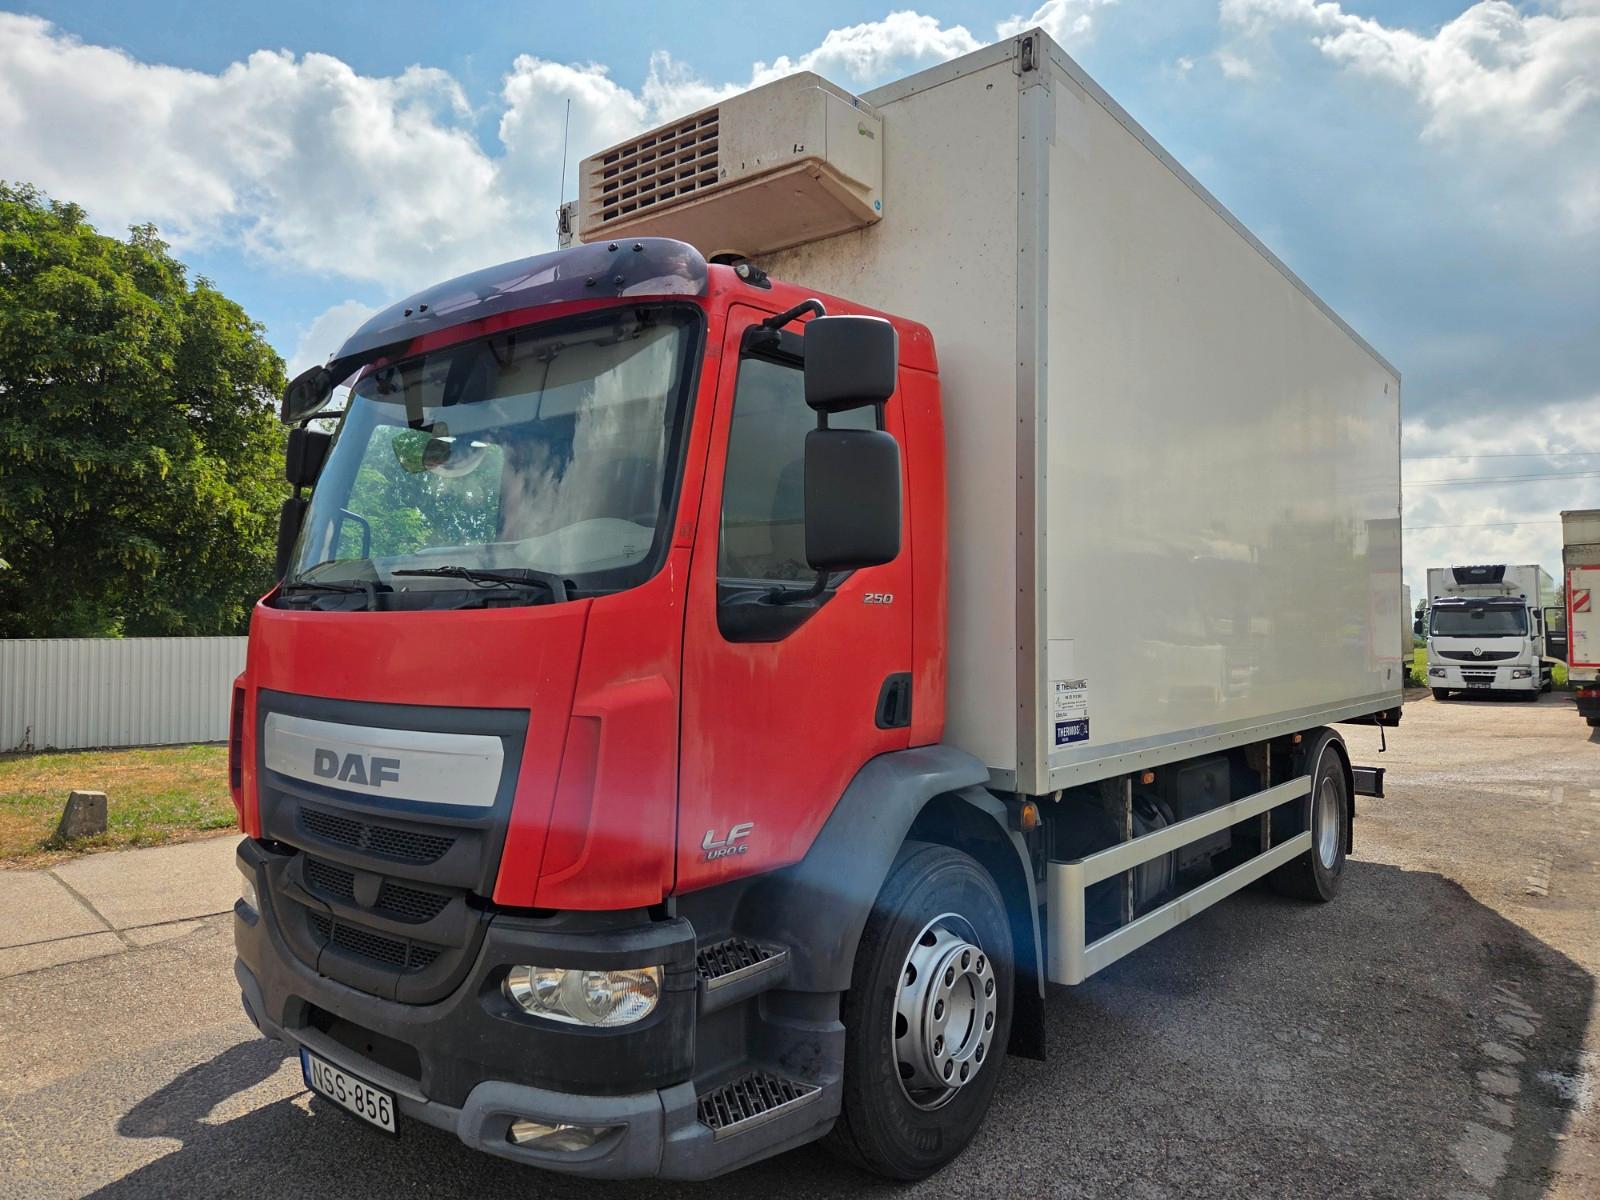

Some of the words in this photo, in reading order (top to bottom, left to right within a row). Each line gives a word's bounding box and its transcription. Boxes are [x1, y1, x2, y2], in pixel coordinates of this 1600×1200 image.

[863, 593, 894, 604] 250
[313, 748, 400, 787] DAF
[702, 822, 754, 850] LF
[312, 1059, 390, 1126] NSS-856
